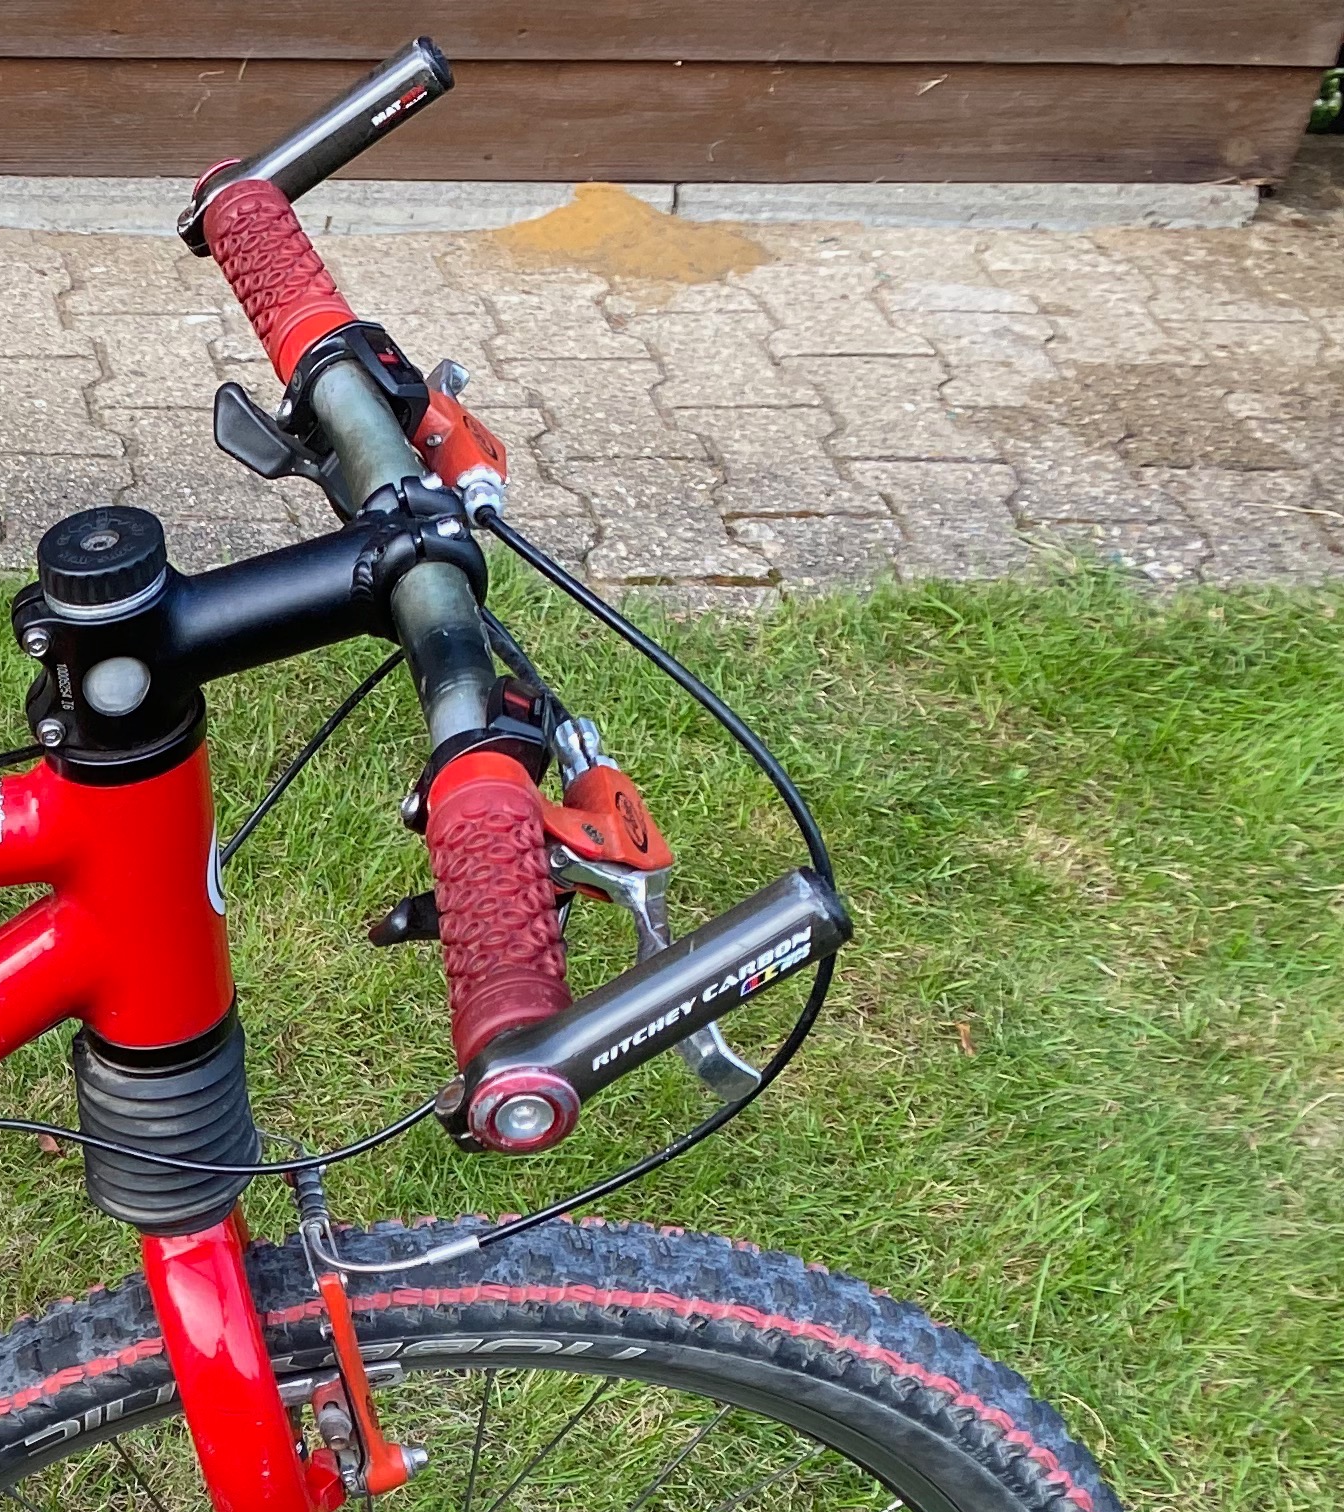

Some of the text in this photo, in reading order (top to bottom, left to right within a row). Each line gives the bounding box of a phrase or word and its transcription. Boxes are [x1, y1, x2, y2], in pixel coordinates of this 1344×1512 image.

[591, 925, 813, 1073] RITCHEY CARBON
[24, 1380, 177, 1457] NIC
